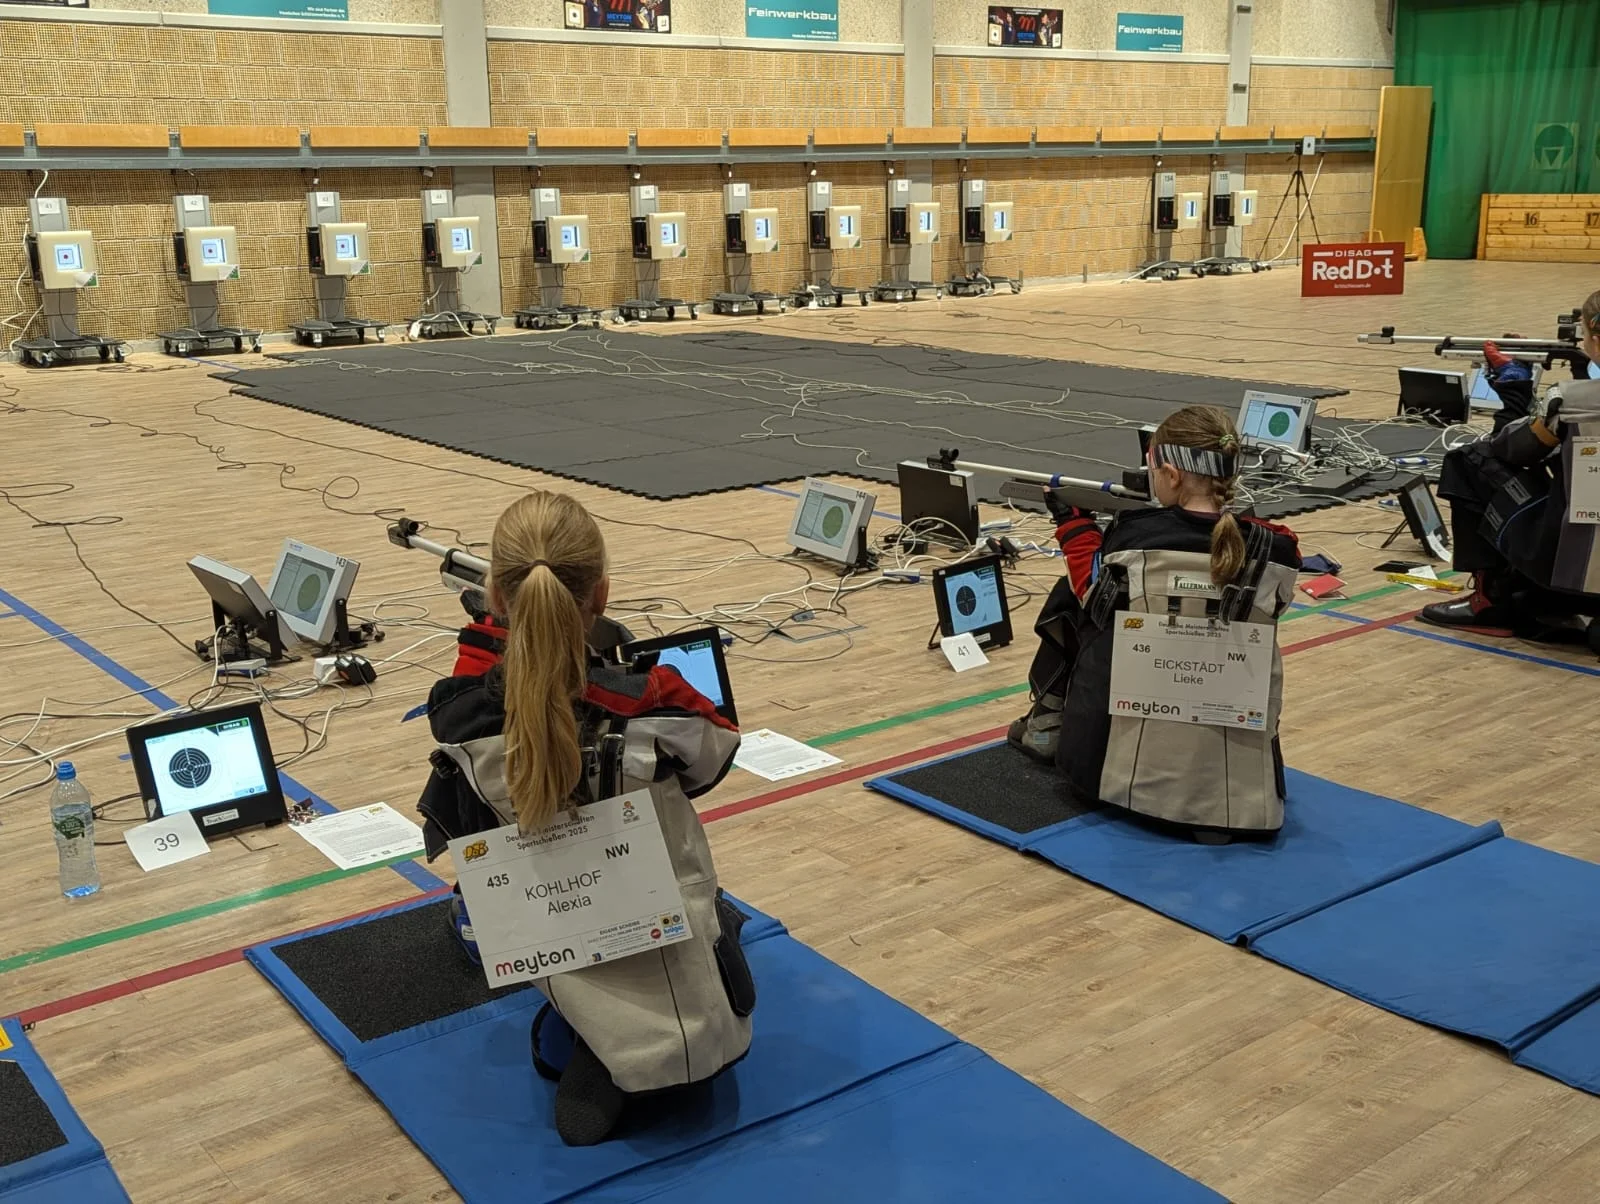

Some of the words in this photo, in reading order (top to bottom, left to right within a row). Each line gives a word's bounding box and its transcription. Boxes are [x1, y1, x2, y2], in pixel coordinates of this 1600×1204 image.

[748, 7, 837, 21] Feinwerkbau
[1118, 25, 1182, 36] Feinwerkbau
[1524, 212, 1537, 226] 16
[1586, 211, 1600, 227] 17
[1334, 249, 1372, 257] DISAG
[856, 490, 867, 500] 144
[336, 556, 347, 567] 143
[957, 645, 970, 657] 41
[1132, 643, 1151, 653] 436
[1227, 652, 1247, 662] NW
[1154, 658, 1225, 674] EICKSTÄDT
[1173, 673, 1204, 685] Lieke
[1117, 700, 1180, 715] meyton
[153, 833, 180, 852] 39
[517, 833, 567, 850] Sportschießen
[568, 826, 589, 837] 2025
[462, 839, 489, 861] DSB
[605, 843, 630, 860] NW
[486, 873, 510, 889] 435
[524, 870, 603, 901] KOHLHOF
[547, 895, 592, 916] Alexia
[495, 948, 576, 977] meyton
